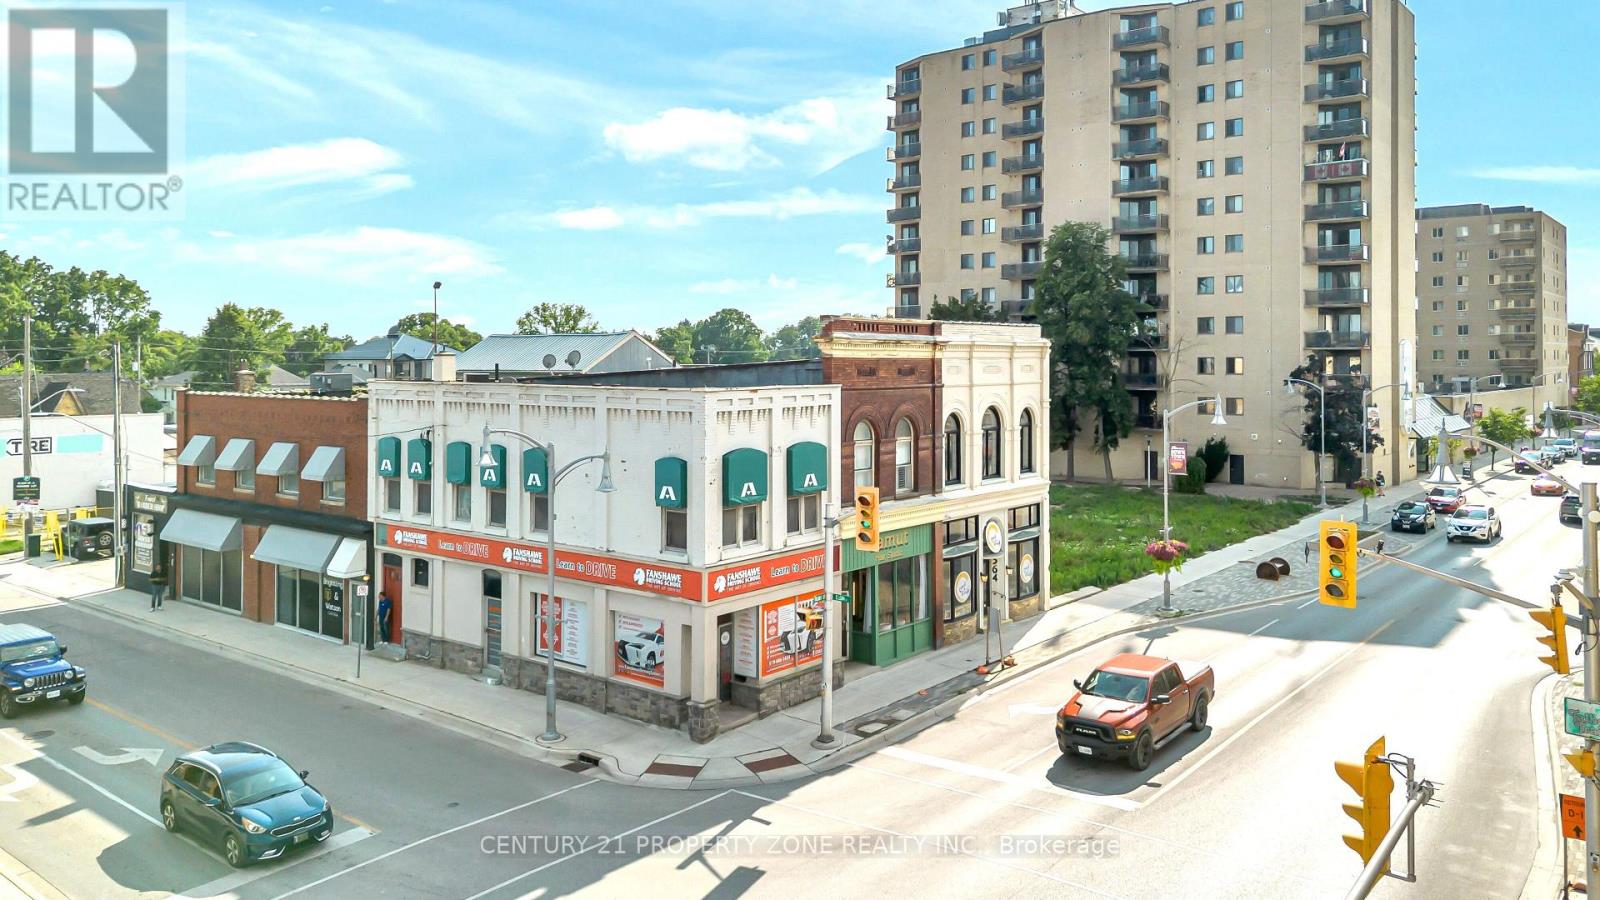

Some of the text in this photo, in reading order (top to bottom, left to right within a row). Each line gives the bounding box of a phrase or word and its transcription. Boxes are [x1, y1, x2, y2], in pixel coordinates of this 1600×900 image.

[11, 440, 49, 453] TRE
[403, 531, 428, 541] FANSHAWE
[438, 540, 455, 551] Learn
[455, 543, 463, 552] to
[462, 542, 489, 558] DRIVE
[513, 548, 543, 559] FANSHAWE
[556, 558, 576, 571] Learn
[577, 563, 585, 573] to
[585, 561, 617, 580] DRIVE
[727, 567, 761, 583] FANSHAWE
[771, 567, 790, 578] Learn
[792, 563, 799, 572] to
[646, 569, 682, 584] FANSHAWE
[646, 577, 682, 589] DRIVING SCHOOL
[727, 575, 761, 587] DRIVING SCHOOL
